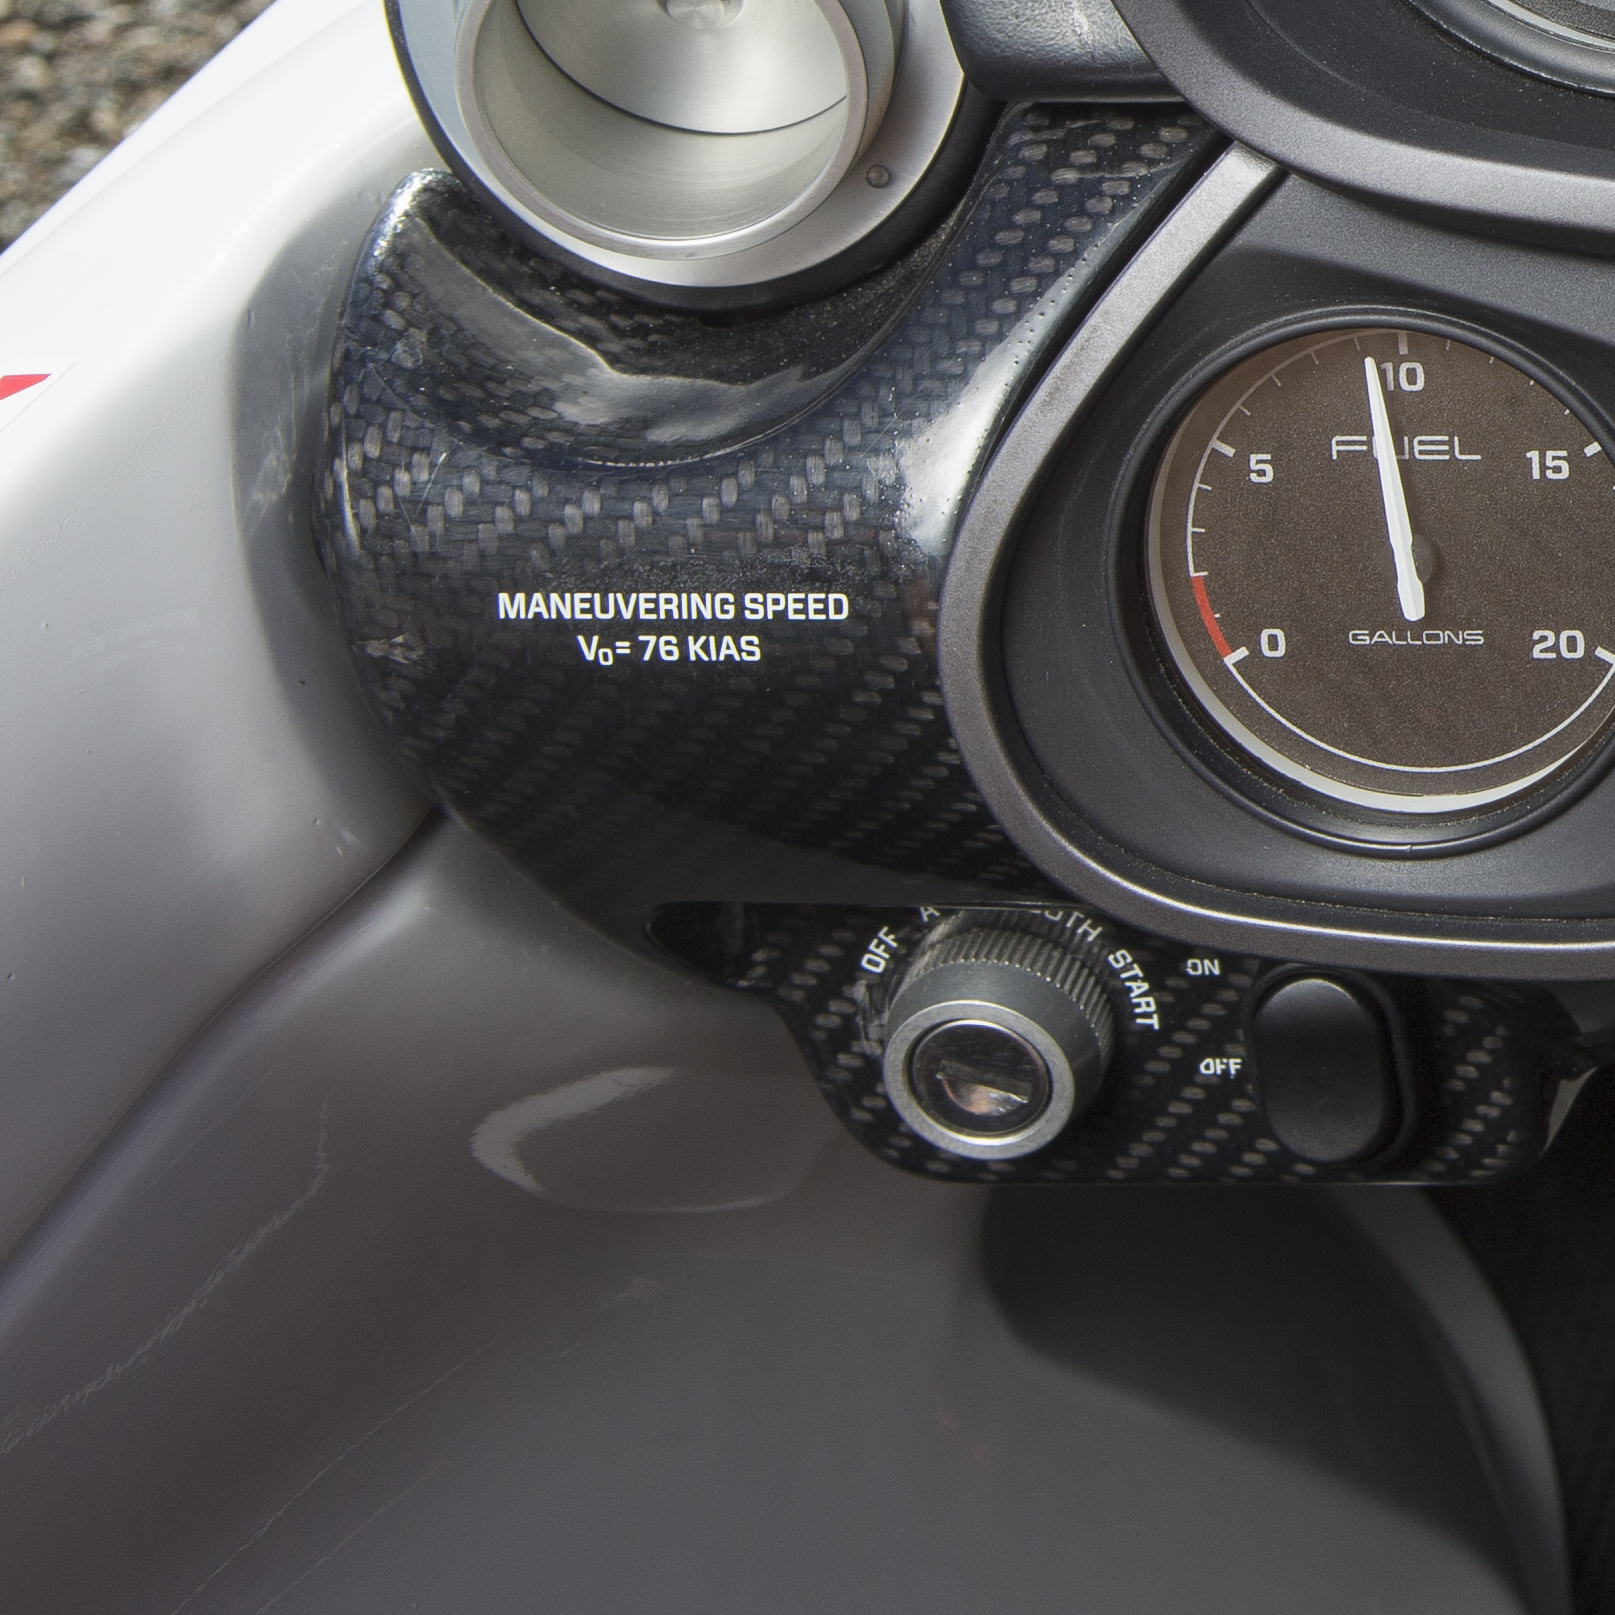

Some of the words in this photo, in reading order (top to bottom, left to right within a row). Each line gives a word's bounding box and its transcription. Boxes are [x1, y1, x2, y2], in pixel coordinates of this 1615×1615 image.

[1380, 361, 1425, 392] 10
[1331, 435, 1483, 461] FUEL
[1248, 453, 1275, 484] 5
[1525, 450, 1570, 481] 15
[498, 591, 735, 620] MANEUVERING
[743, 591, 850, 621] SPEED
[636, 634, 680, 662] 76
[687, 634, 762, 662] KIAS
[1260, 628, 1287, 659] 0
[1348, 629, 1485, 646] GALLONS
[1531, 629, 1586, 660] 20
[1030, 910, 1103, 942] OTH
[860, 925, 899, 974] OFF
[1186, 958, 1220, 976] ON
[1107, 948, 1160, 1031] START
[1199, 1057, 1242, 1076] OFF
